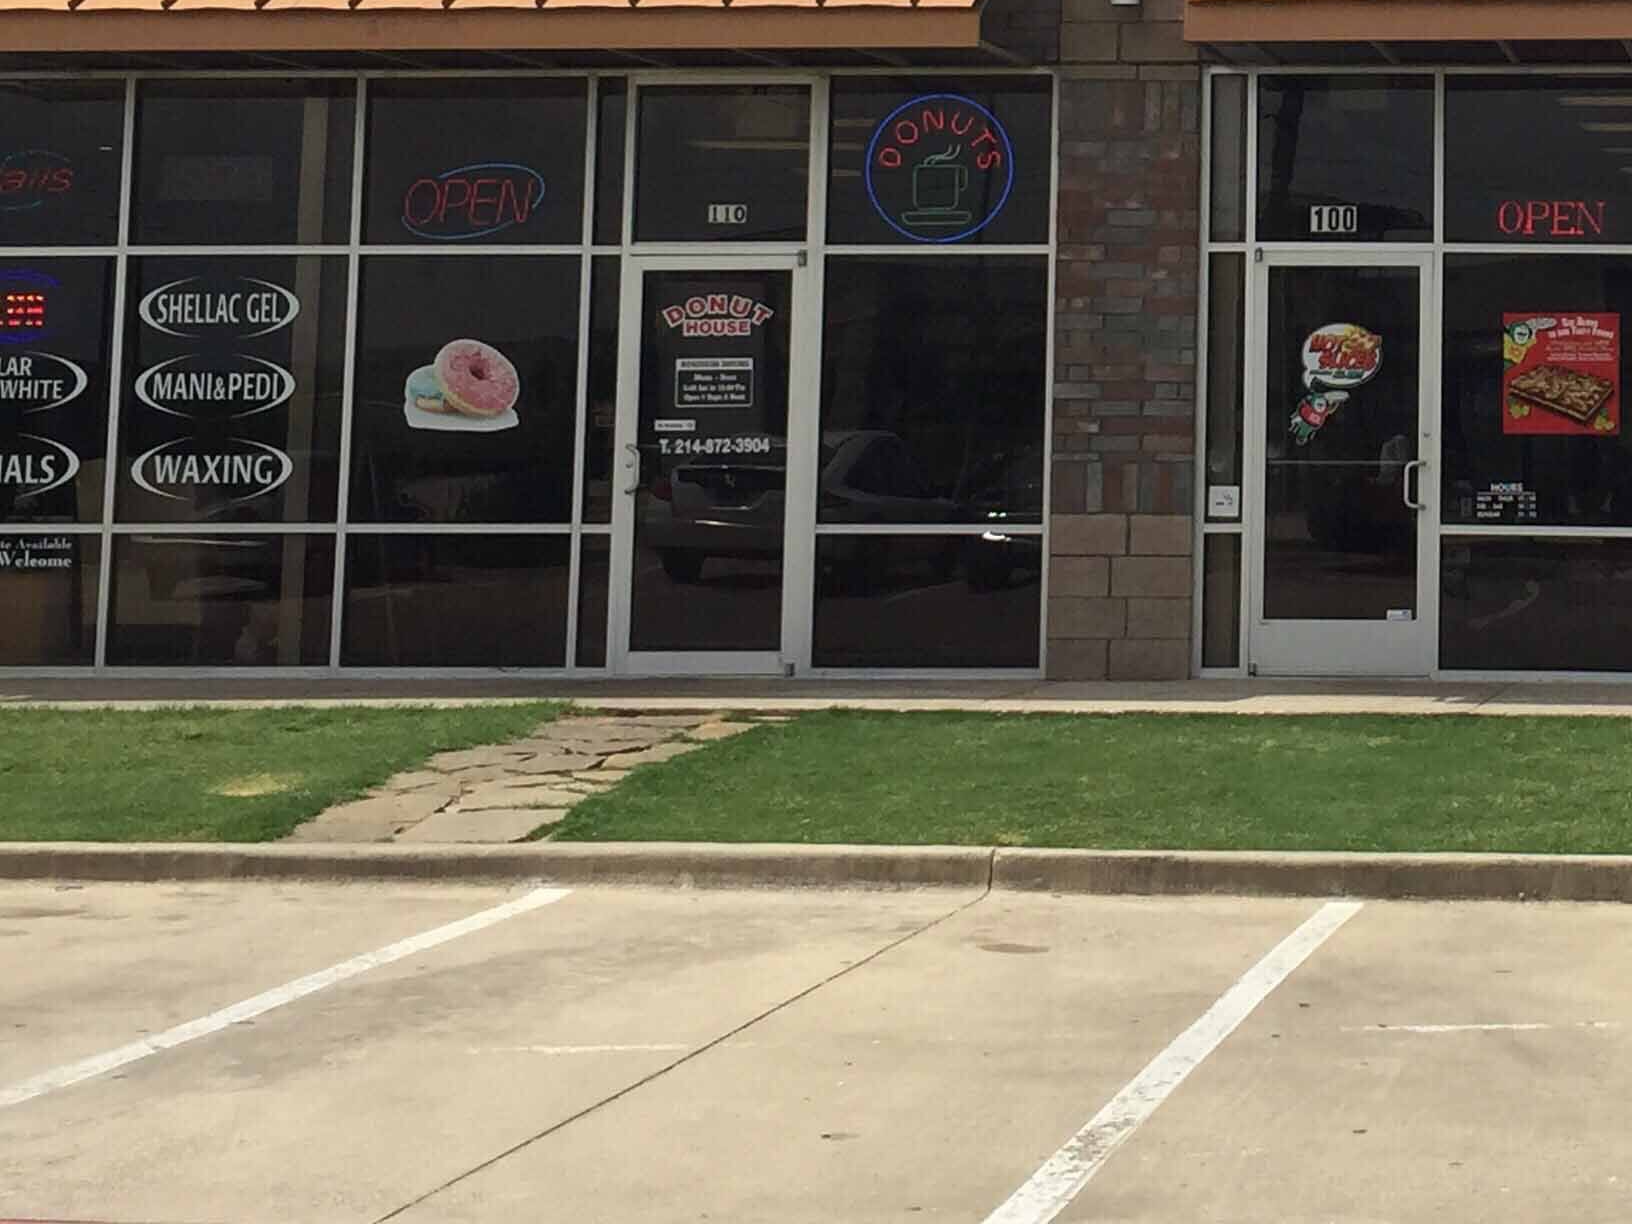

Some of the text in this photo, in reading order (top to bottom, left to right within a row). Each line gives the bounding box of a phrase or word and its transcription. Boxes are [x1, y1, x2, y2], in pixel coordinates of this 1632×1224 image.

[879, 110, 1002, 170] DONUTS
[403, 176, 537, 225] OPEN
[710, 205, 745, 222] 110
[1313, 207, 1355, 231] 100
[1498, 200, 1607, 236] OPEN
[155, 292, 282, 325] SHELLAC GEL
[662, 294, 774, 328] DONUT
[683, 318, 752, 336] HOUSE
[0, 379, 63, 400] WHITE
[152, 372, 280, 402] MANI&PEDI
[154, 454, 274, 485] WAXING
[1490, 483, 1523, 493] HOURS
[16, 537, 73, 550] Available
[0, 550, 73, 568] Welcome
